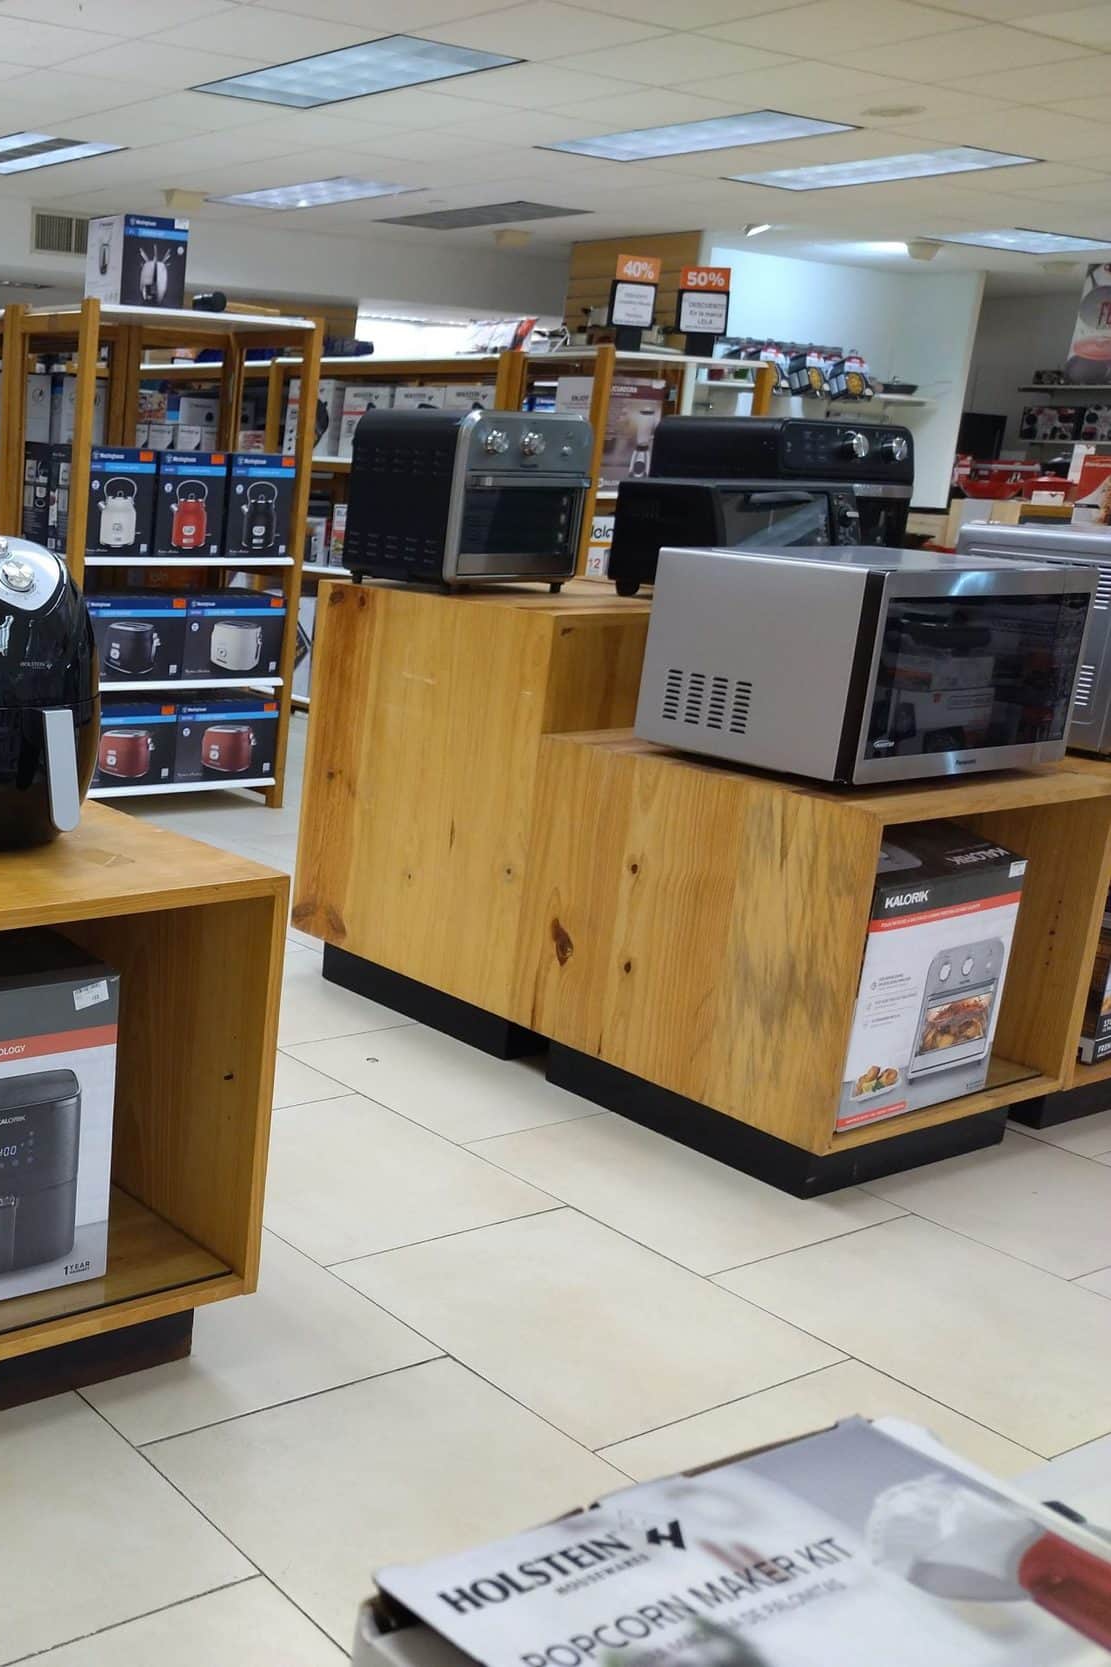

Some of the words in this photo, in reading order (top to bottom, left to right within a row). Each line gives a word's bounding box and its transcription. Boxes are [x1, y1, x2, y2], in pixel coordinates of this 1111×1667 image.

[623, 260, 655, 280] 40%
[687, 271, 725, 287] 50%
[884, 890, 929, 909] KALORIK
[64, 1265, 68, 1275] 1
[69, 1261, 90, 1270] YEAR
[437, 1531, 632, 1615] HOLSTEIN
[555, 1552, 651, 1597] HOUSEWARES
[520, 1594, 699, 1667] POPCORN
[688, 1555, 809, 1610] MAKER
[794, 1538, 854, 1570] KIT
